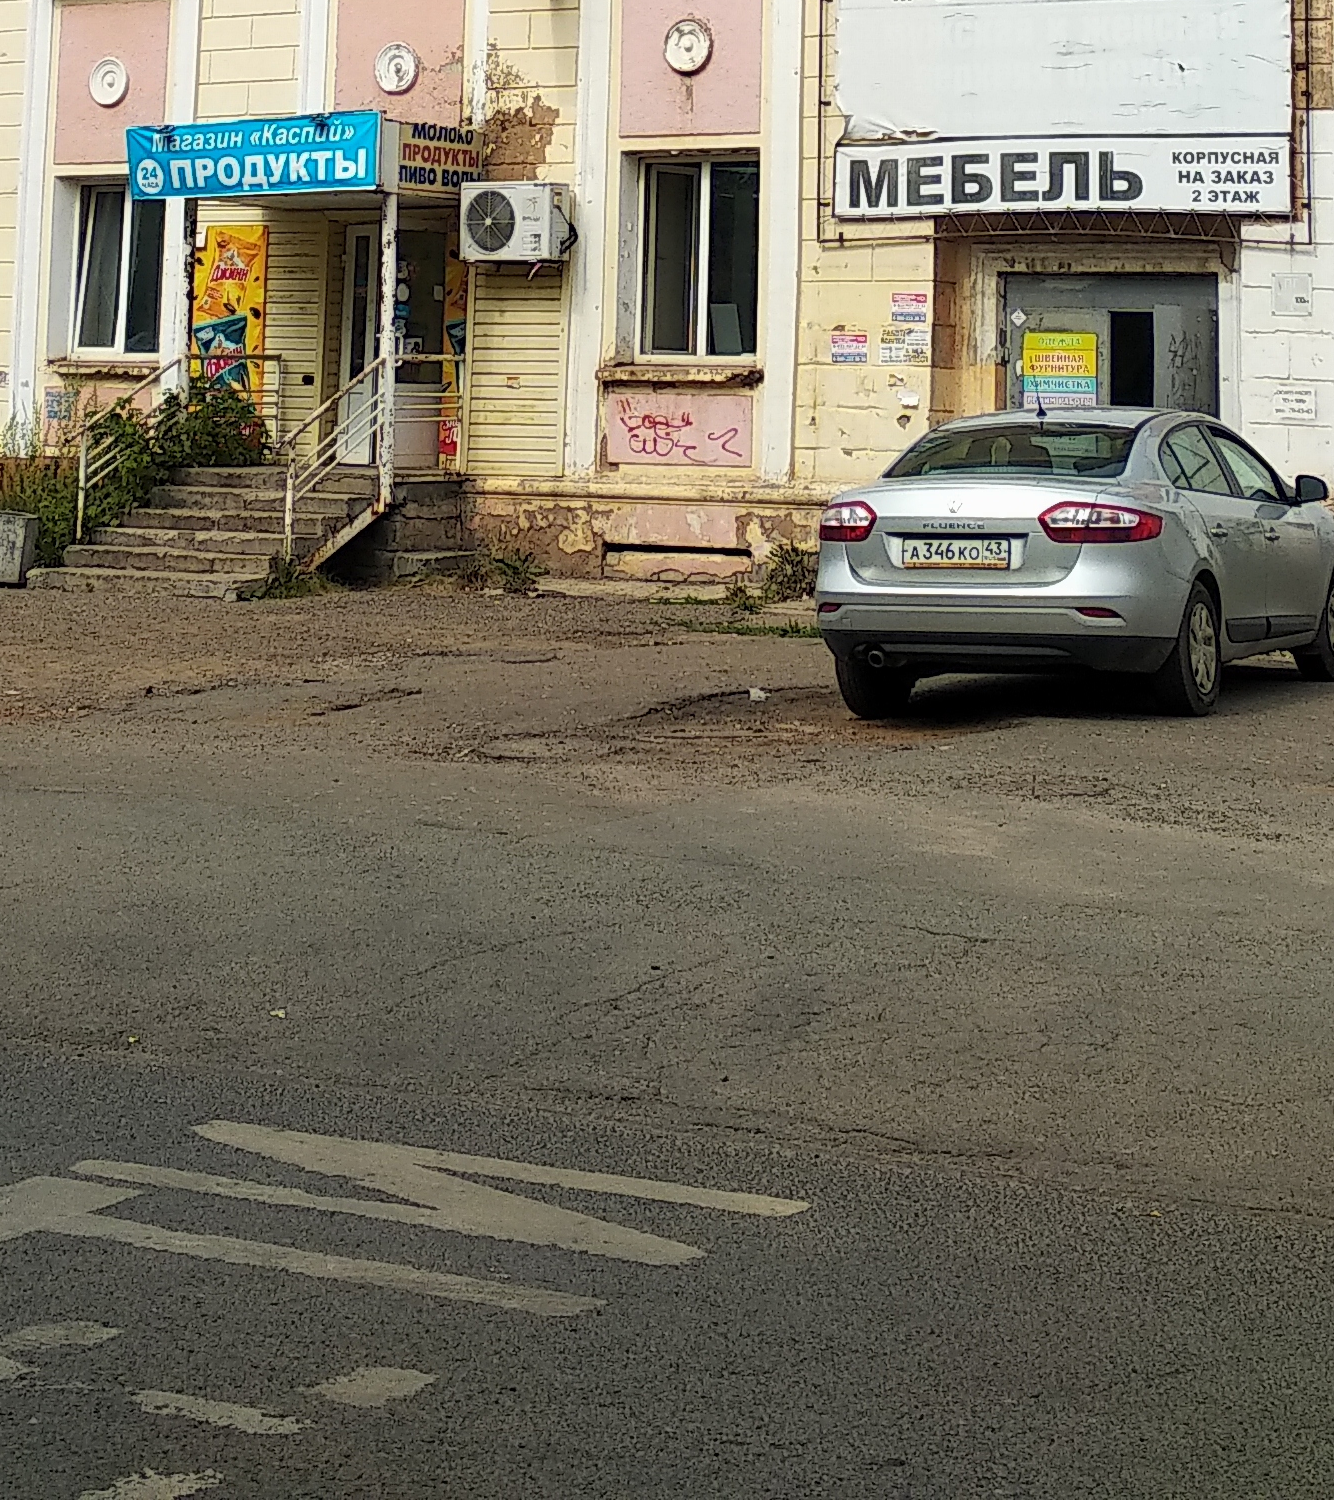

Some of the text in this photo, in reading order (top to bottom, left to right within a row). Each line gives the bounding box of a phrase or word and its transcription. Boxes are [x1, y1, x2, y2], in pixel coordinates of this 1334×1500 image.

[152, 119, 355, 152] Магазин «Каспий»
[411, 123, 474, 145] МОЛОКО
[402, 142, 480, 168] ПРОДУКТЫ
[1171, 149, 1280, 166] КОРПУСНАЯ
[140, 165, 159, 180] 24
[169, 148, 367, 191] ПРОДУКТЫ
[399, 165, 438, 185] ПИВО
[1178, 168, 1275, 185] НА ЗАКАЗ
[848, 150, 1143, 209] МЕБЕЛЬ
[1191, 188, 1261, 204] 2 ЭТАЖ
[1034, 352, 1084, 363] ШВЕЙНАЯ
[1028, 364, 1090, 373] ФУРНИТУРА
[1028, 379, 1091, 389] ХИМЧИСТКА
[1058, 396, 1093, 406] РАБОТЫ
[922, 522, 986, 530] FLUENCE
[984, 541, 1003, 555] 43
